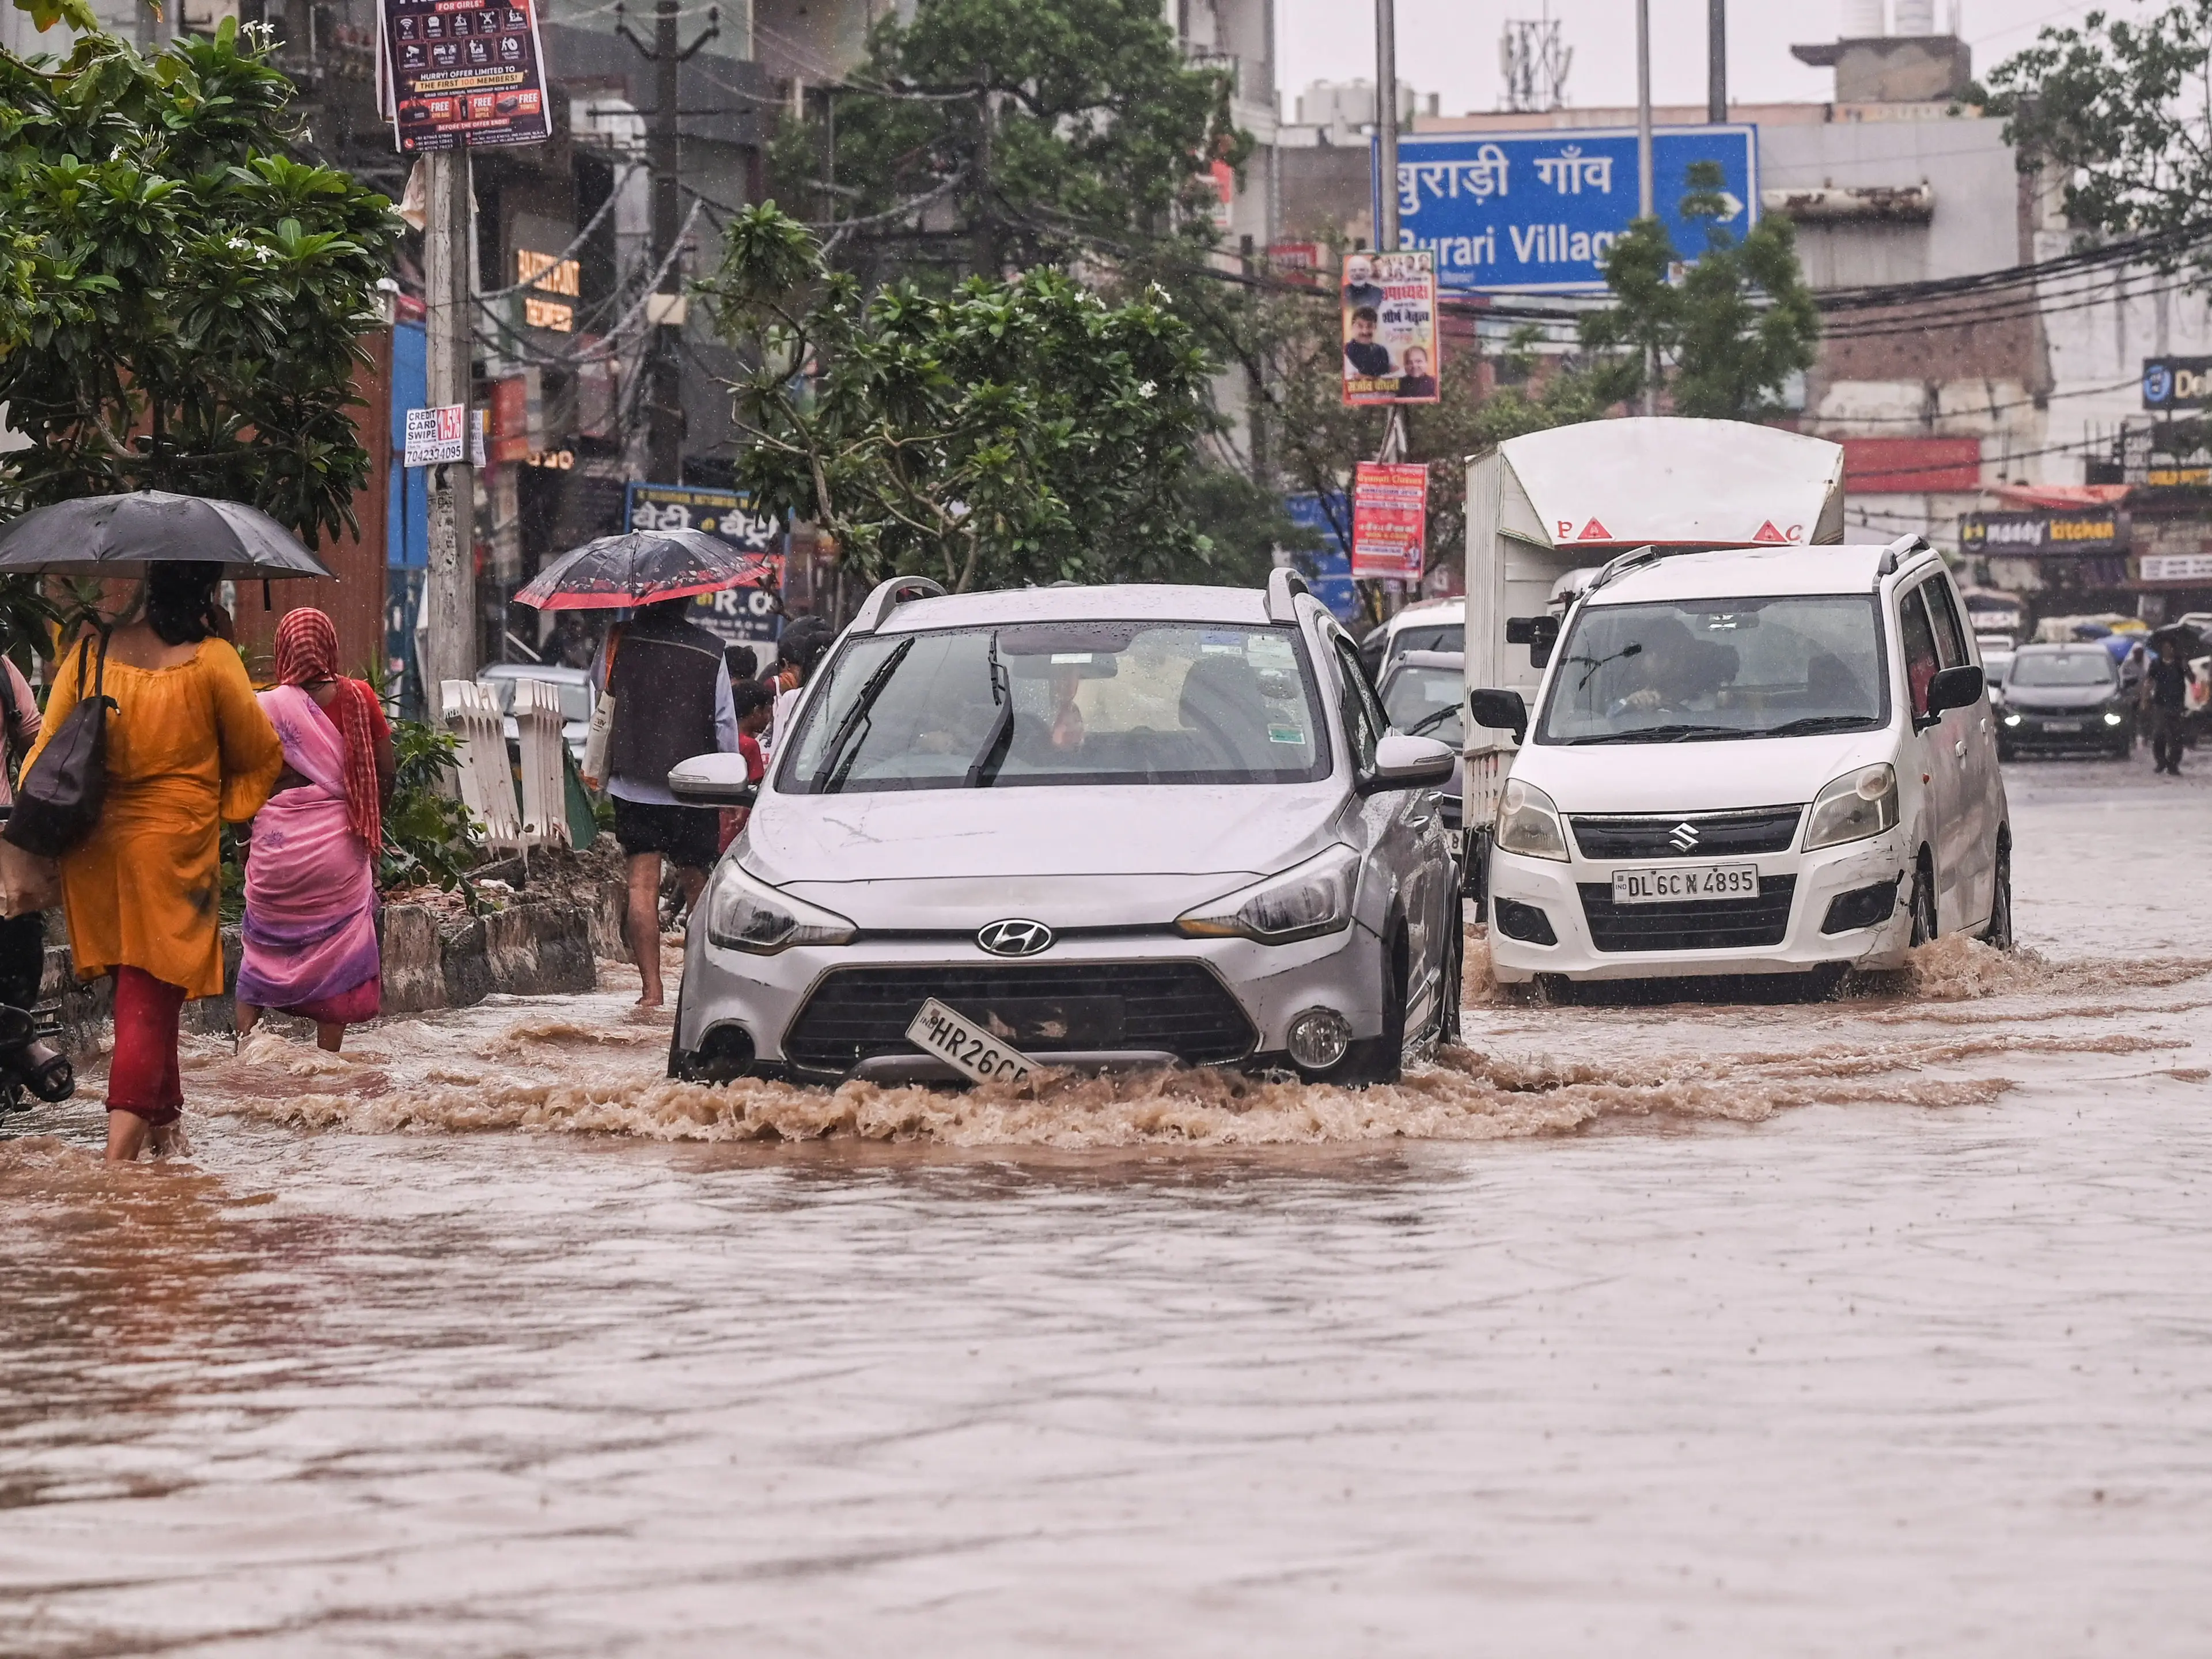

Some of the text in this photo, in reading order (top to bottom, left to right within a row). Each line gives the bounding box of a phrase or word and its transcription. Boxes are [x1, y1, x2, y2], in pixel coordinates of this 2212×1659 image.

[438, 2, 454, 11] FOR
[421, 71, 448, 81] HURRY!
[450, 69, 473, 78] OFFER
[475, 67, 503, 76] LIMITED
[461, 78, 475, 86] 100
[477, 75, 517, 85] MEMBERS!
[474, 97, 492, 107] FREE
[519, 92, 538, 103] FREE
[431, 101, 449, 112] FREE
[1399, 145, 1613, 215] बुराड़ी गाँव
[1509, 224, 1633, 268] Villag
[409, 409, 436, 421] CREDIT
[408, 420, 436, 430] CARD
[438, 408, 460, 440] 1.5%
[408, 430, 436, 440] SWIPE
[407, 446, 461, 463] 7042334095
[1557, 520, 1803, 541] P C
